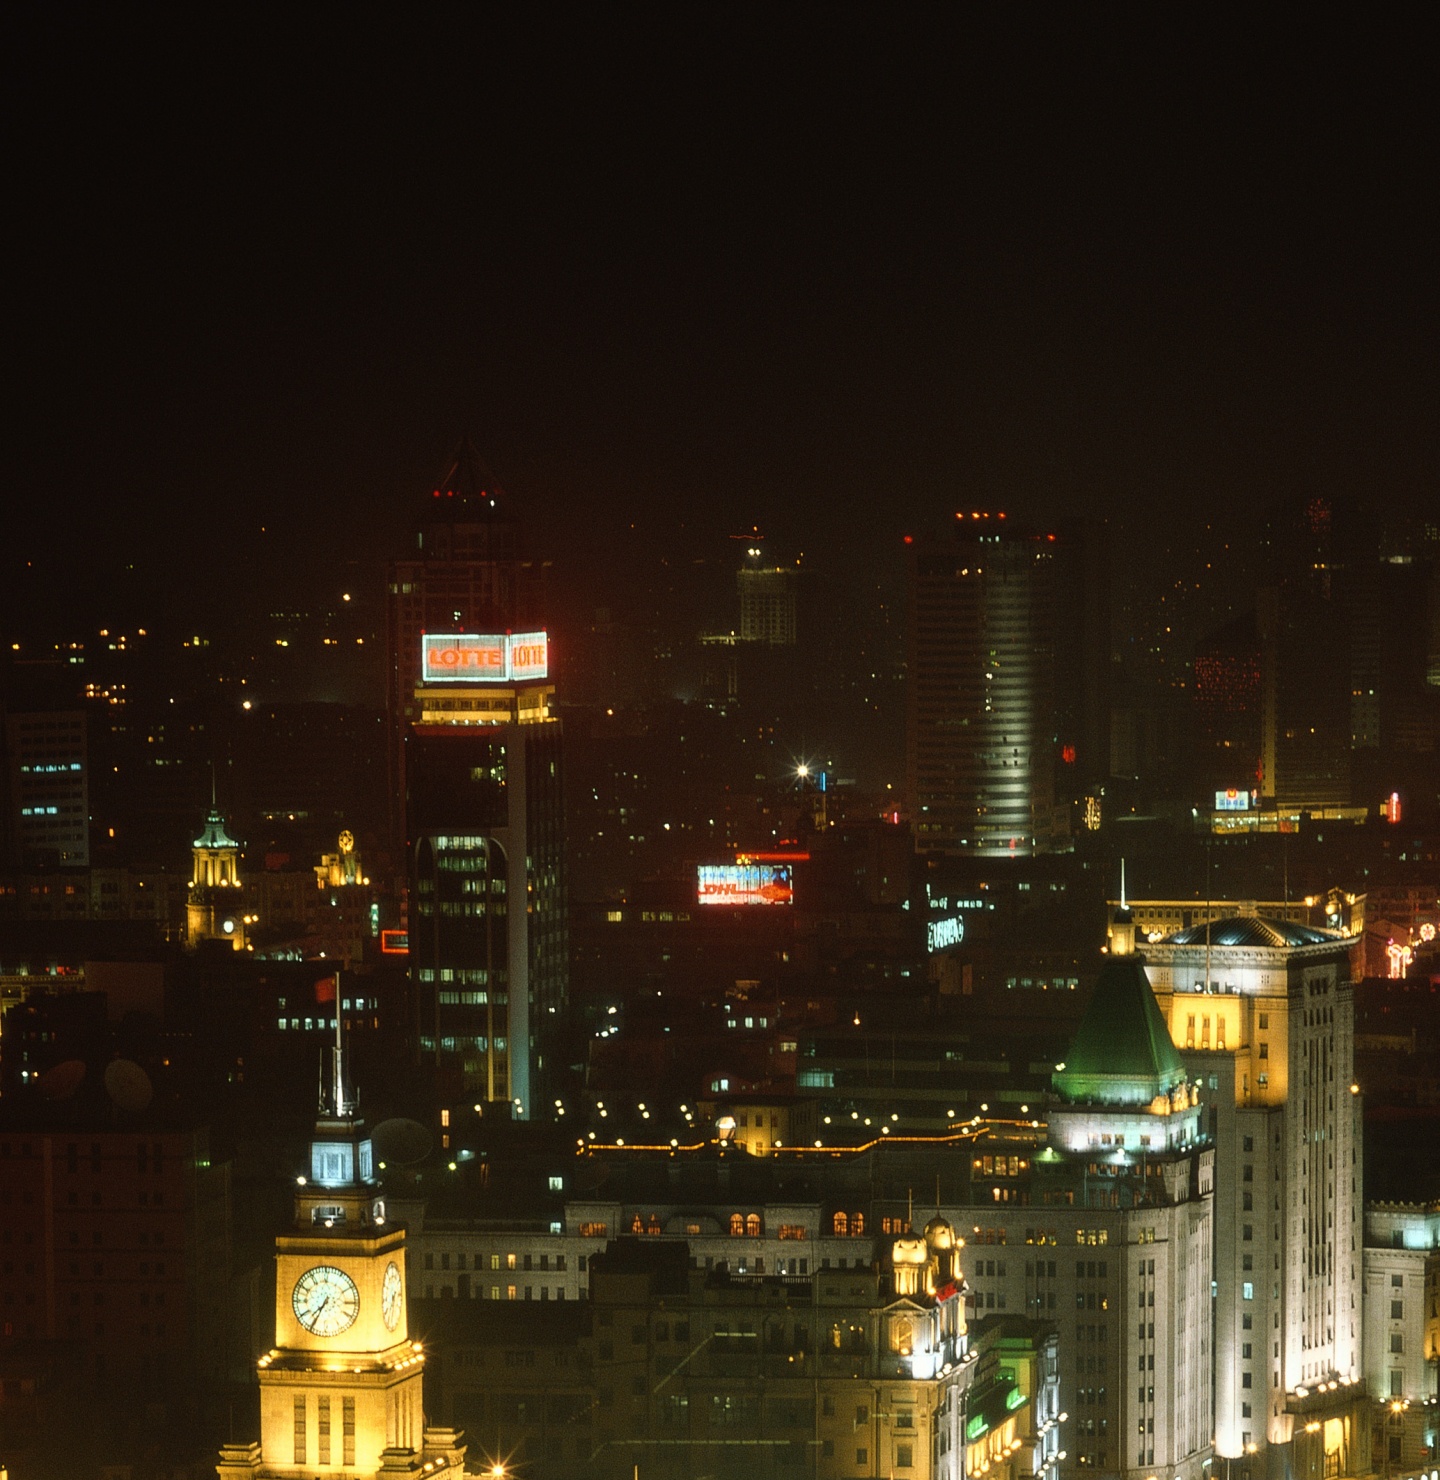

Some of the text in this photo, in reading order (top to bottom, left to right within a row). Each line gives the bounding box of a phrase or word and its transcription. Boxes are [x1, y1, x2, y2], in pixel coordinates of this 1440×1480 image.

[429, 649, 502, 667] LOTTE
[513, 645, 545, 667] LOTTE
[704, 884, 737, 895] DHL
